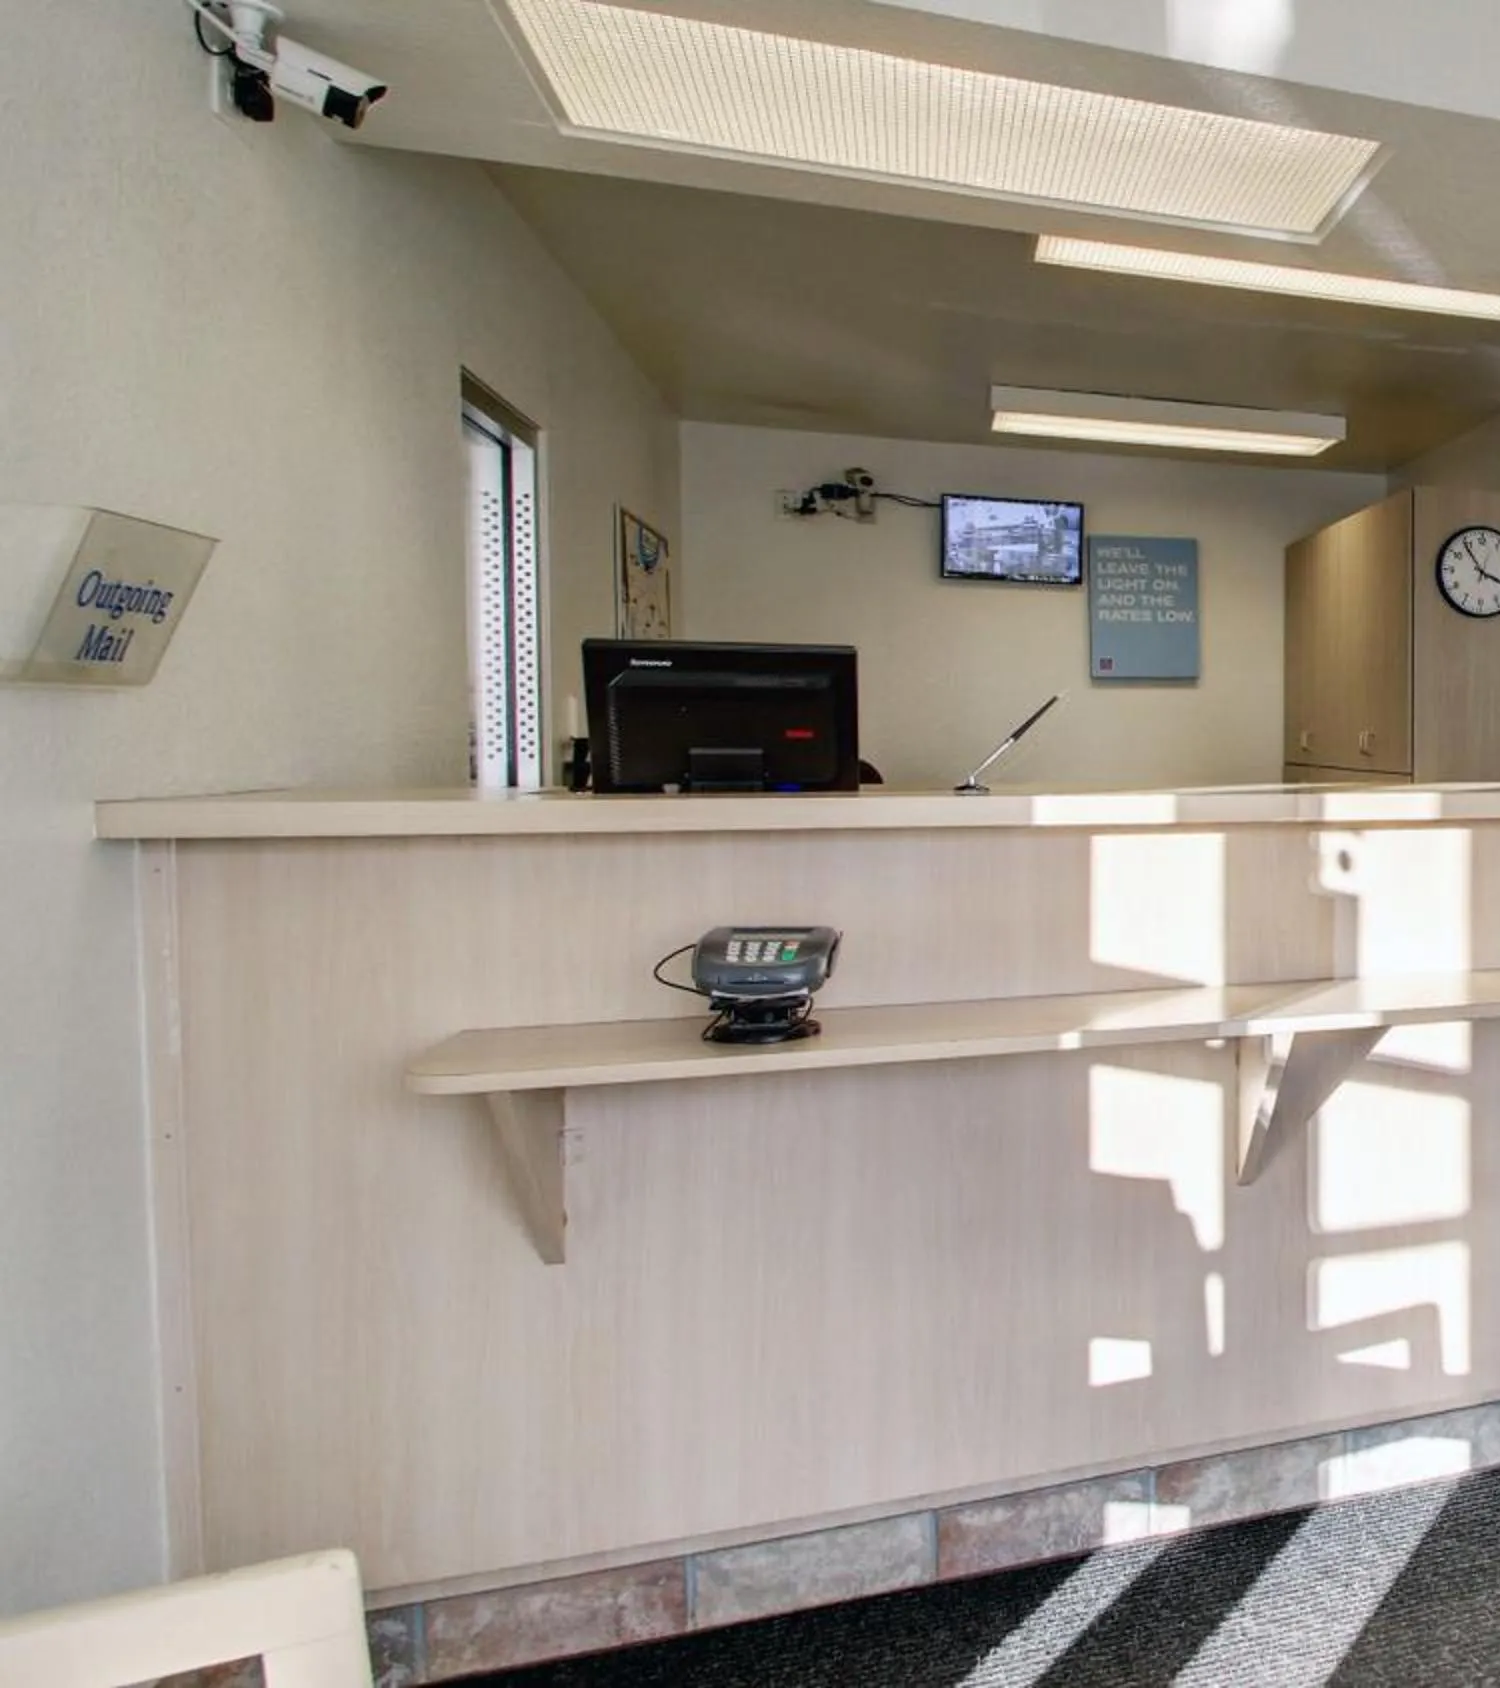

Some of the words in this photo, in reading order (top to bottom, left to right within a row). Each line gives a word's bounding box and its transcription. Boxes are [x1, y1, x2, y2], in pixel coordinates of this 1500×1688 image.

[1097, 562, 1149, 575] LEAVE
[1154, 563, 1188, 577] THE
[1097, 578, 1148, 591] LIGHT
[77, 570, 174, 624] Outgoing
[1098, 594, 1136, 607] AND
[1140, 594, 1177, 607] THE
[1098, 609, 1153, 622] RATES
[74, 624, 134, 662] Mail
